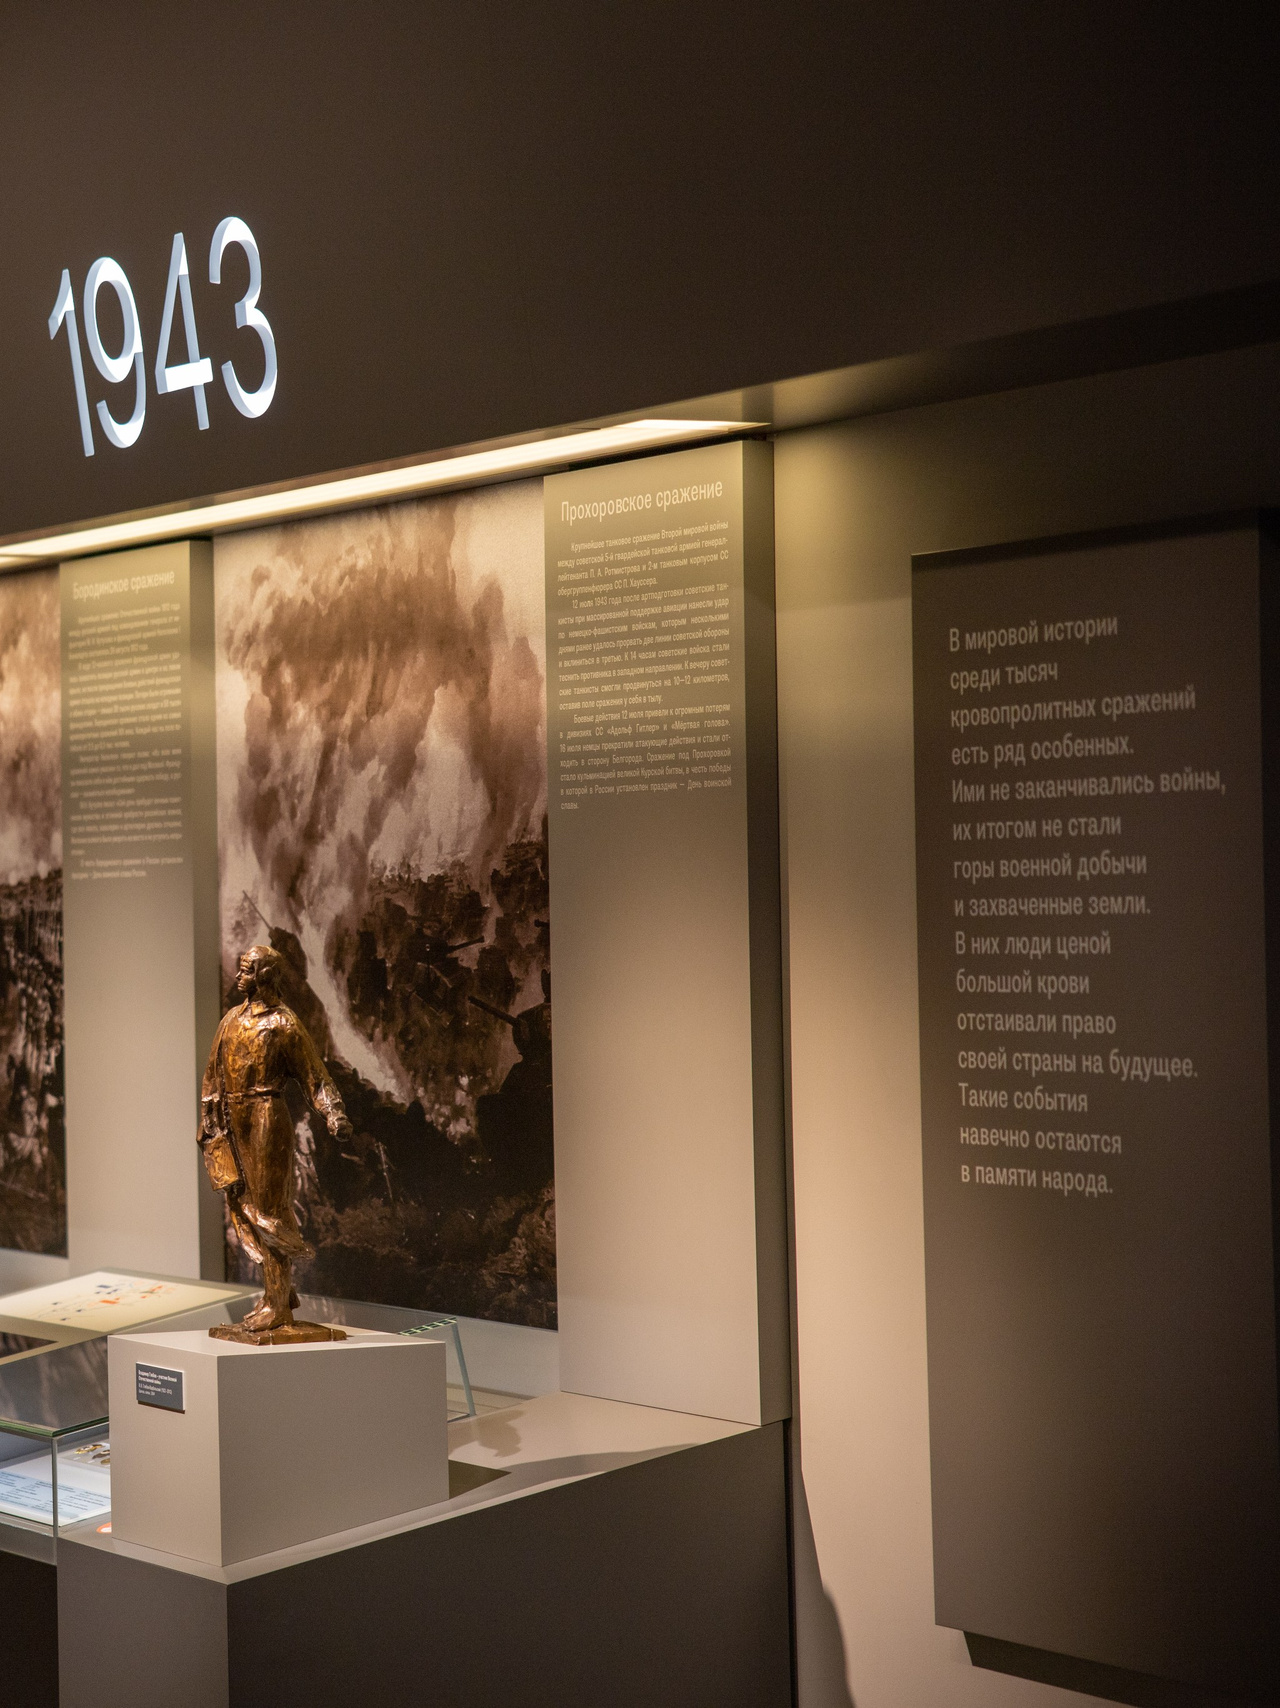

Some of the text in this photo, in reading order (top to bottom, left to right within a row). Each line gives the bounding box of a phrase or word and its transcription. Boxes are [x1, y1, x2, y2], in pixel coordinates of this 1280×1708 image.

[48, 216, 277, 457] 1943
[561, 481, 723, 526] Прохоровское сражение
[73, 571, 175, 602] Бородинское сражение
[950, 619, 1118, 654] В мировой истории
[950, 663, 1058, 695] среди тысяч
[951, 684, 1196, 733] кровопролитных сражений
[952, 733, 1134, 769] есть ряд особенных.
[952, 766, 1226, 803] Ими не заканчивались войны,
[953, 817, 1121, 840] их итогом не стали
[954, 849, 1147, 885] горы военной добычи
[955, 896, 1151, 917] и захваченные земли.
[956, 930, 1111, 959] В них люди ценой
[956, 969, 1089, 1000] большой крови
[957, 1014, 1116, 1039] отстаивали право
[958, 1046, 1198, 1082] своей страны на будущее.
[960, 1082, 1088, 1112] Такие события
[960, 1127, 1122, 1153] навечно остаются
[961, 1165, 1113, 1197] в памяти народа.
